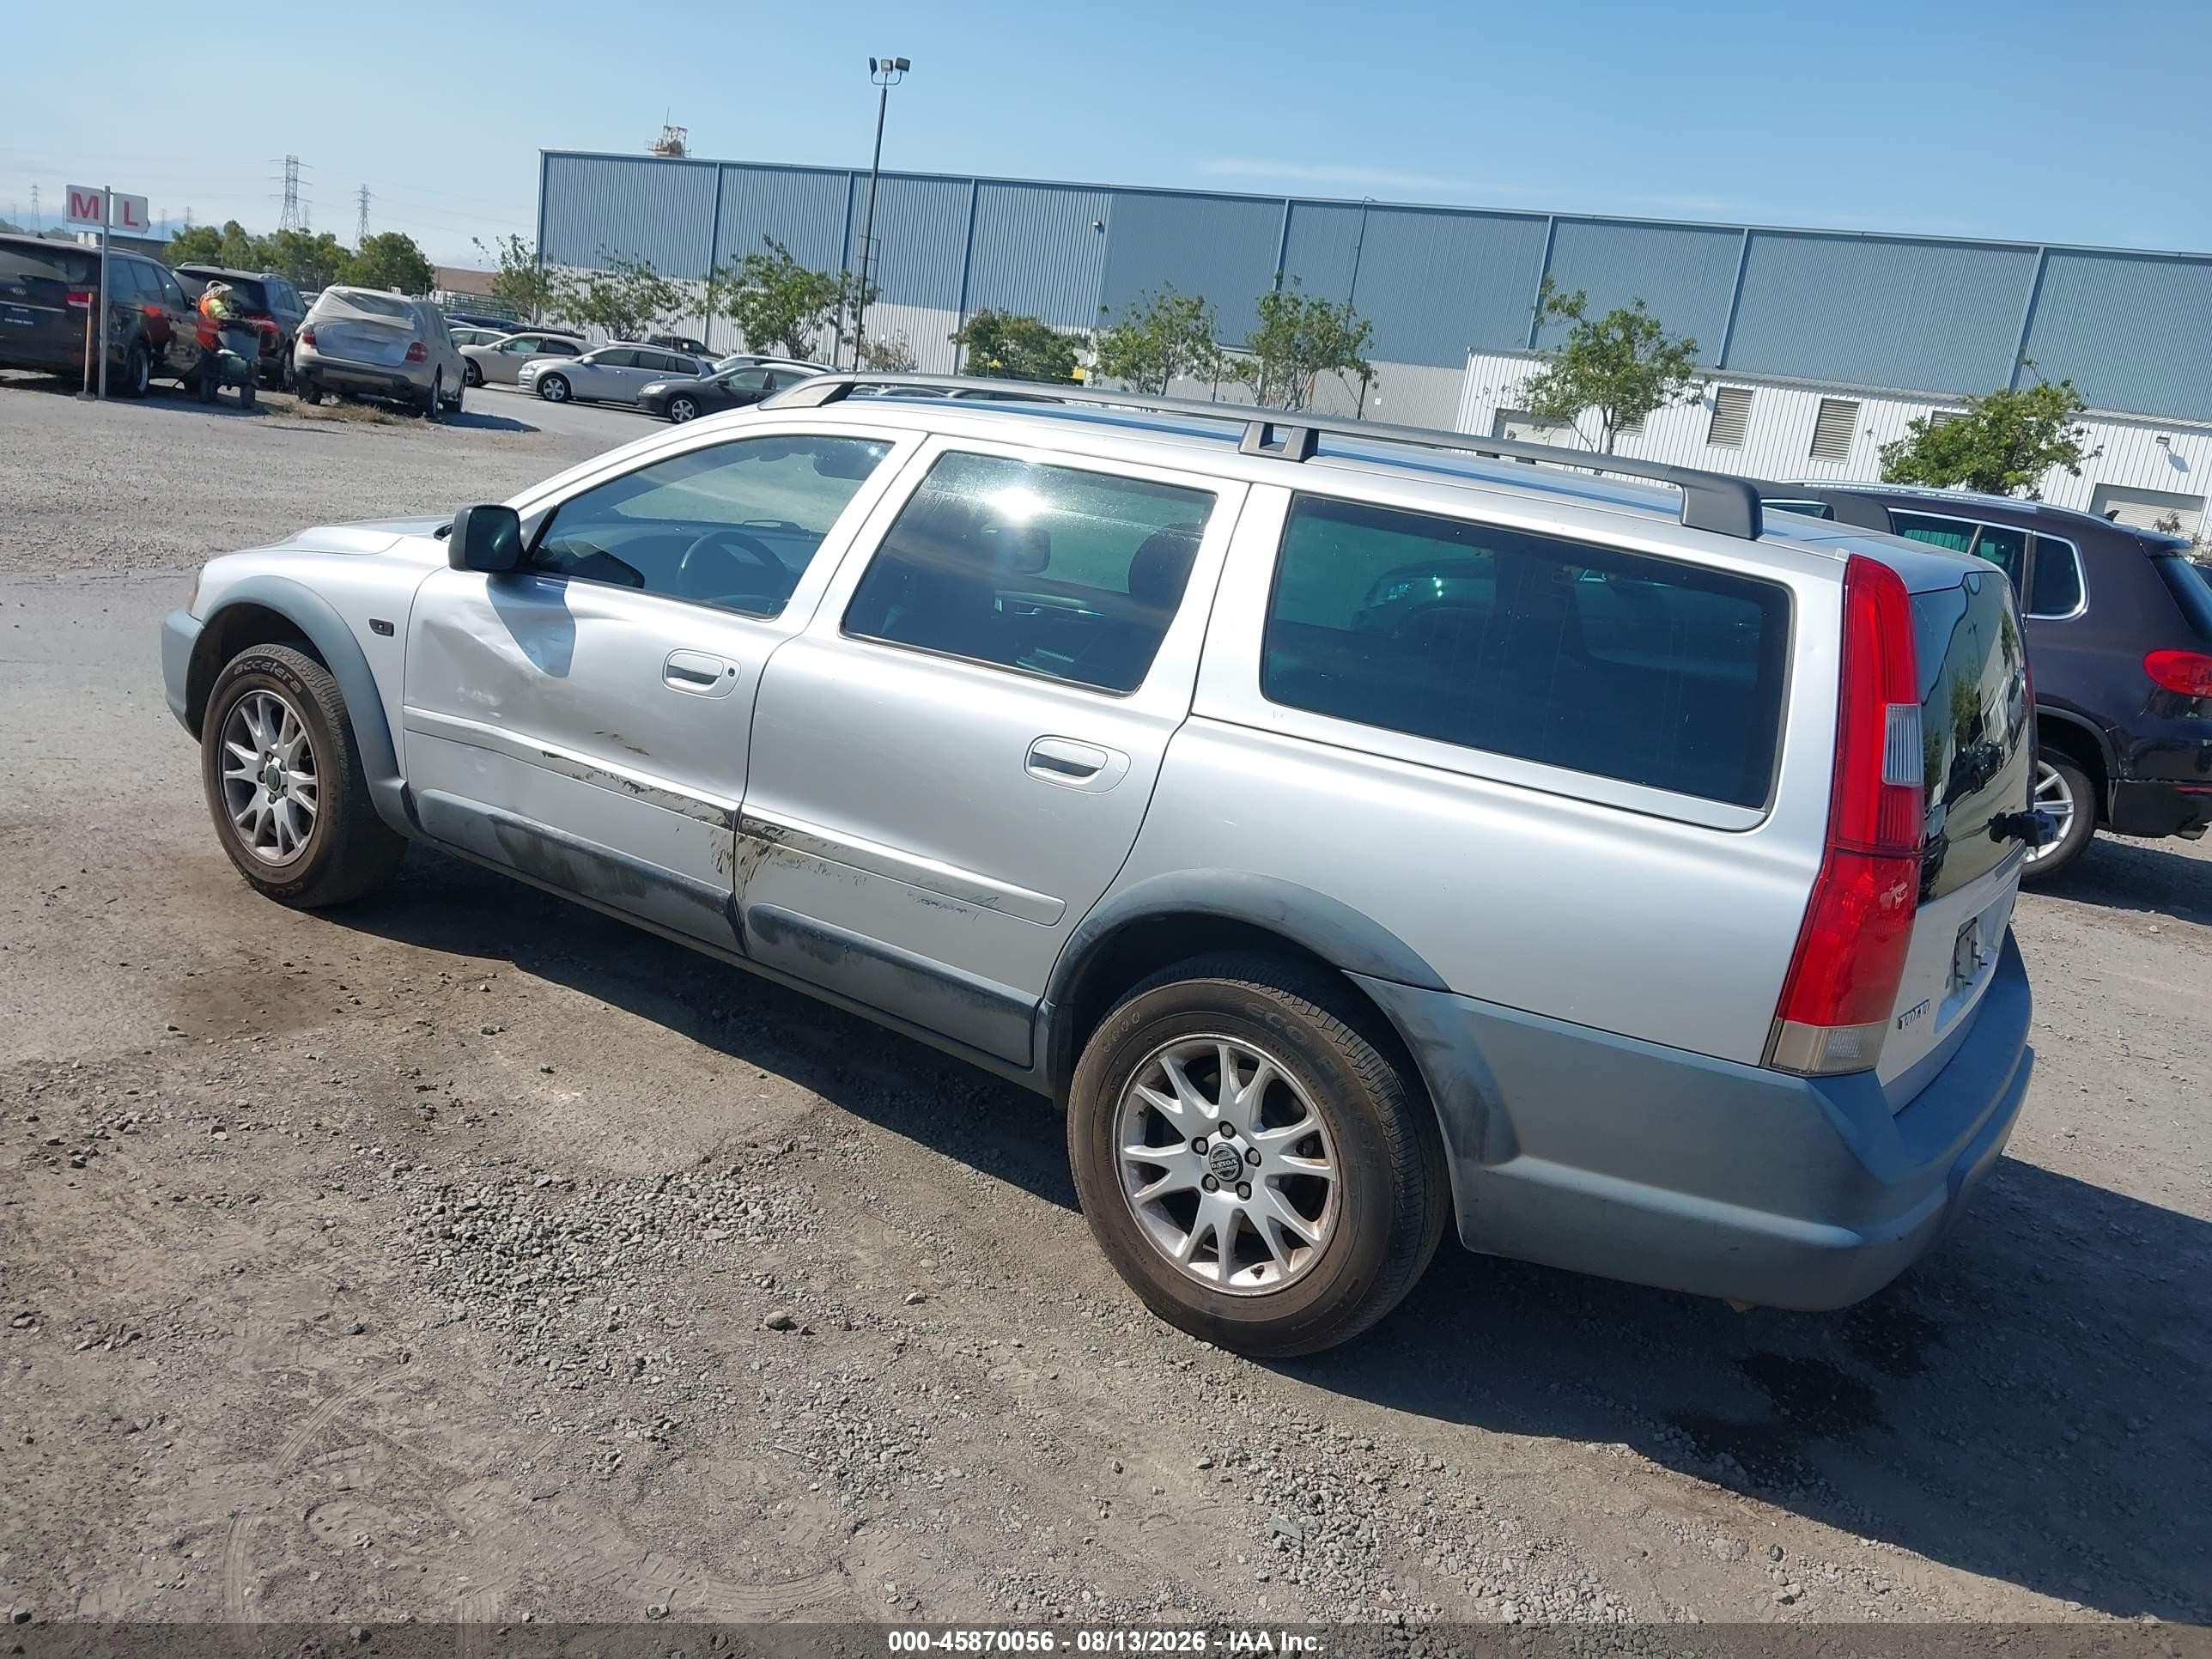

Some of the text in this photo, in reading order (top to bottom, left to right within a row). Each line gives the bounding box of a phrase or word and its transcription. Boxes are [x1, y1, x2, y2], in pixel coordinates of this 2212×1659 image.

[71, 191, 99, 221] M
[123, 200, 139, 228] L
[233, 659, 302, 694] accelera
[1211, 1158, 1238, 1170] VOLVO
